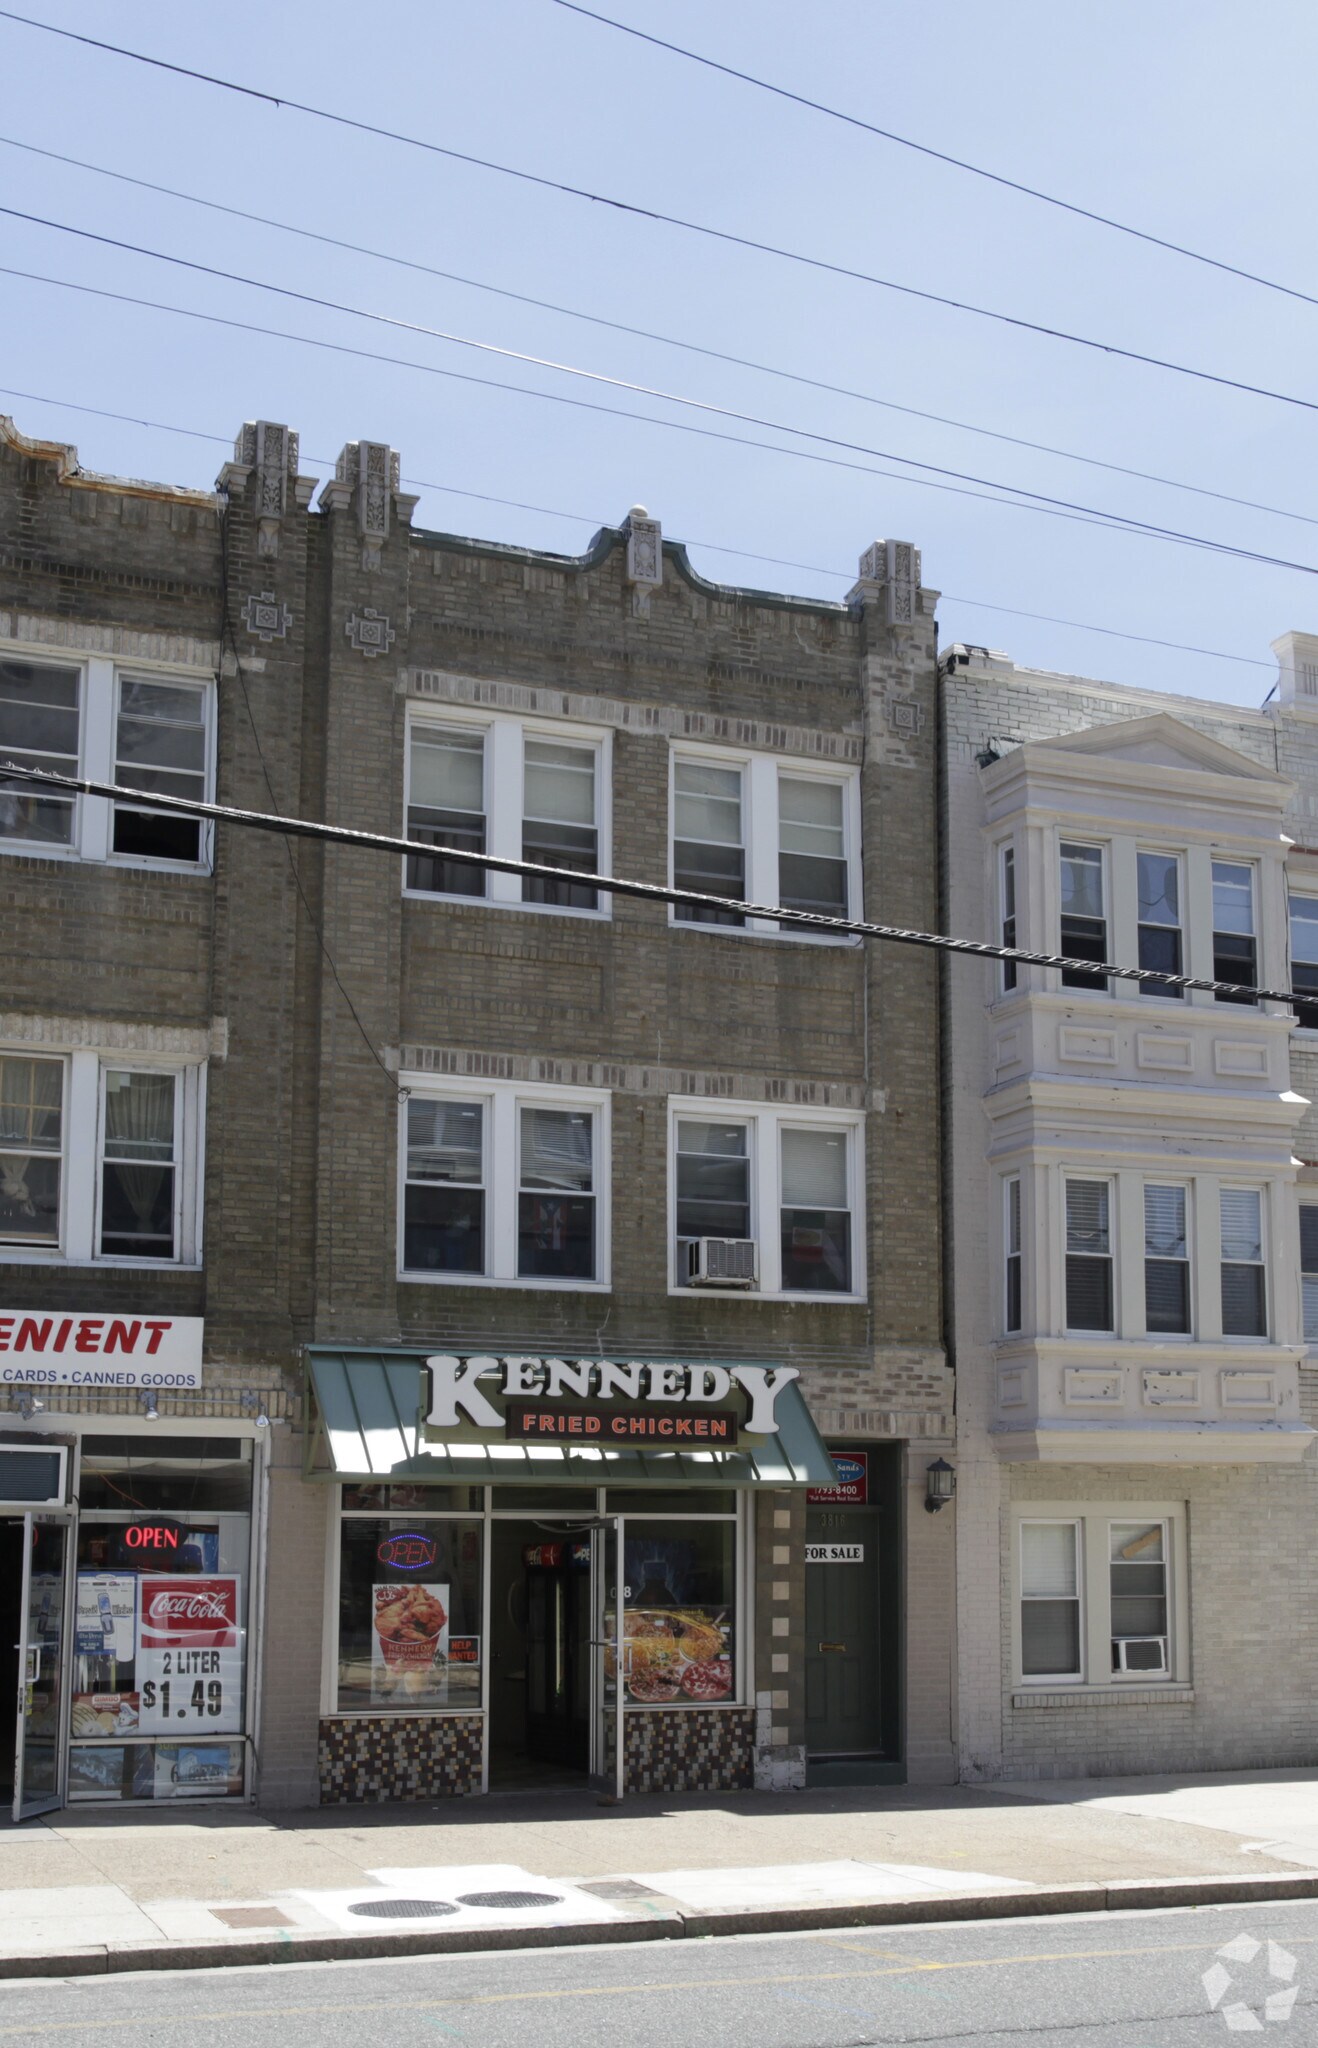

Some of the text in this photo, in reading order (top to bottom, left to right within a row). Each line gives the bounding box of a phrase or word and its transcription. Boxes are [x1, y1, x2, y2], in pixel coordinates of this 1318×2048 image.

[3, 1369, 196, 1386] CARDS CANNED GOODS
[425, 1354, 801, 1434] KENNEDY
[523, 1414, 727, 1436] FRIED CHICKEN
[837, 1464, 860, 1472] Sands
[125, 1526, 179, 1549] OPEN
[377, 1541, 438, 1564] OPEN
[805, 1547, 861, 1559] FOR SALE
[148, 1591, 231, 1620] Coca-Cola
[388, 1643, 433, 1652] KENNEDY
[451, 1640, 471, 1650] HELP
[162, 1651, 221, 1675] 2 LITER
[143, 1680, 222, 1718] $1.49
